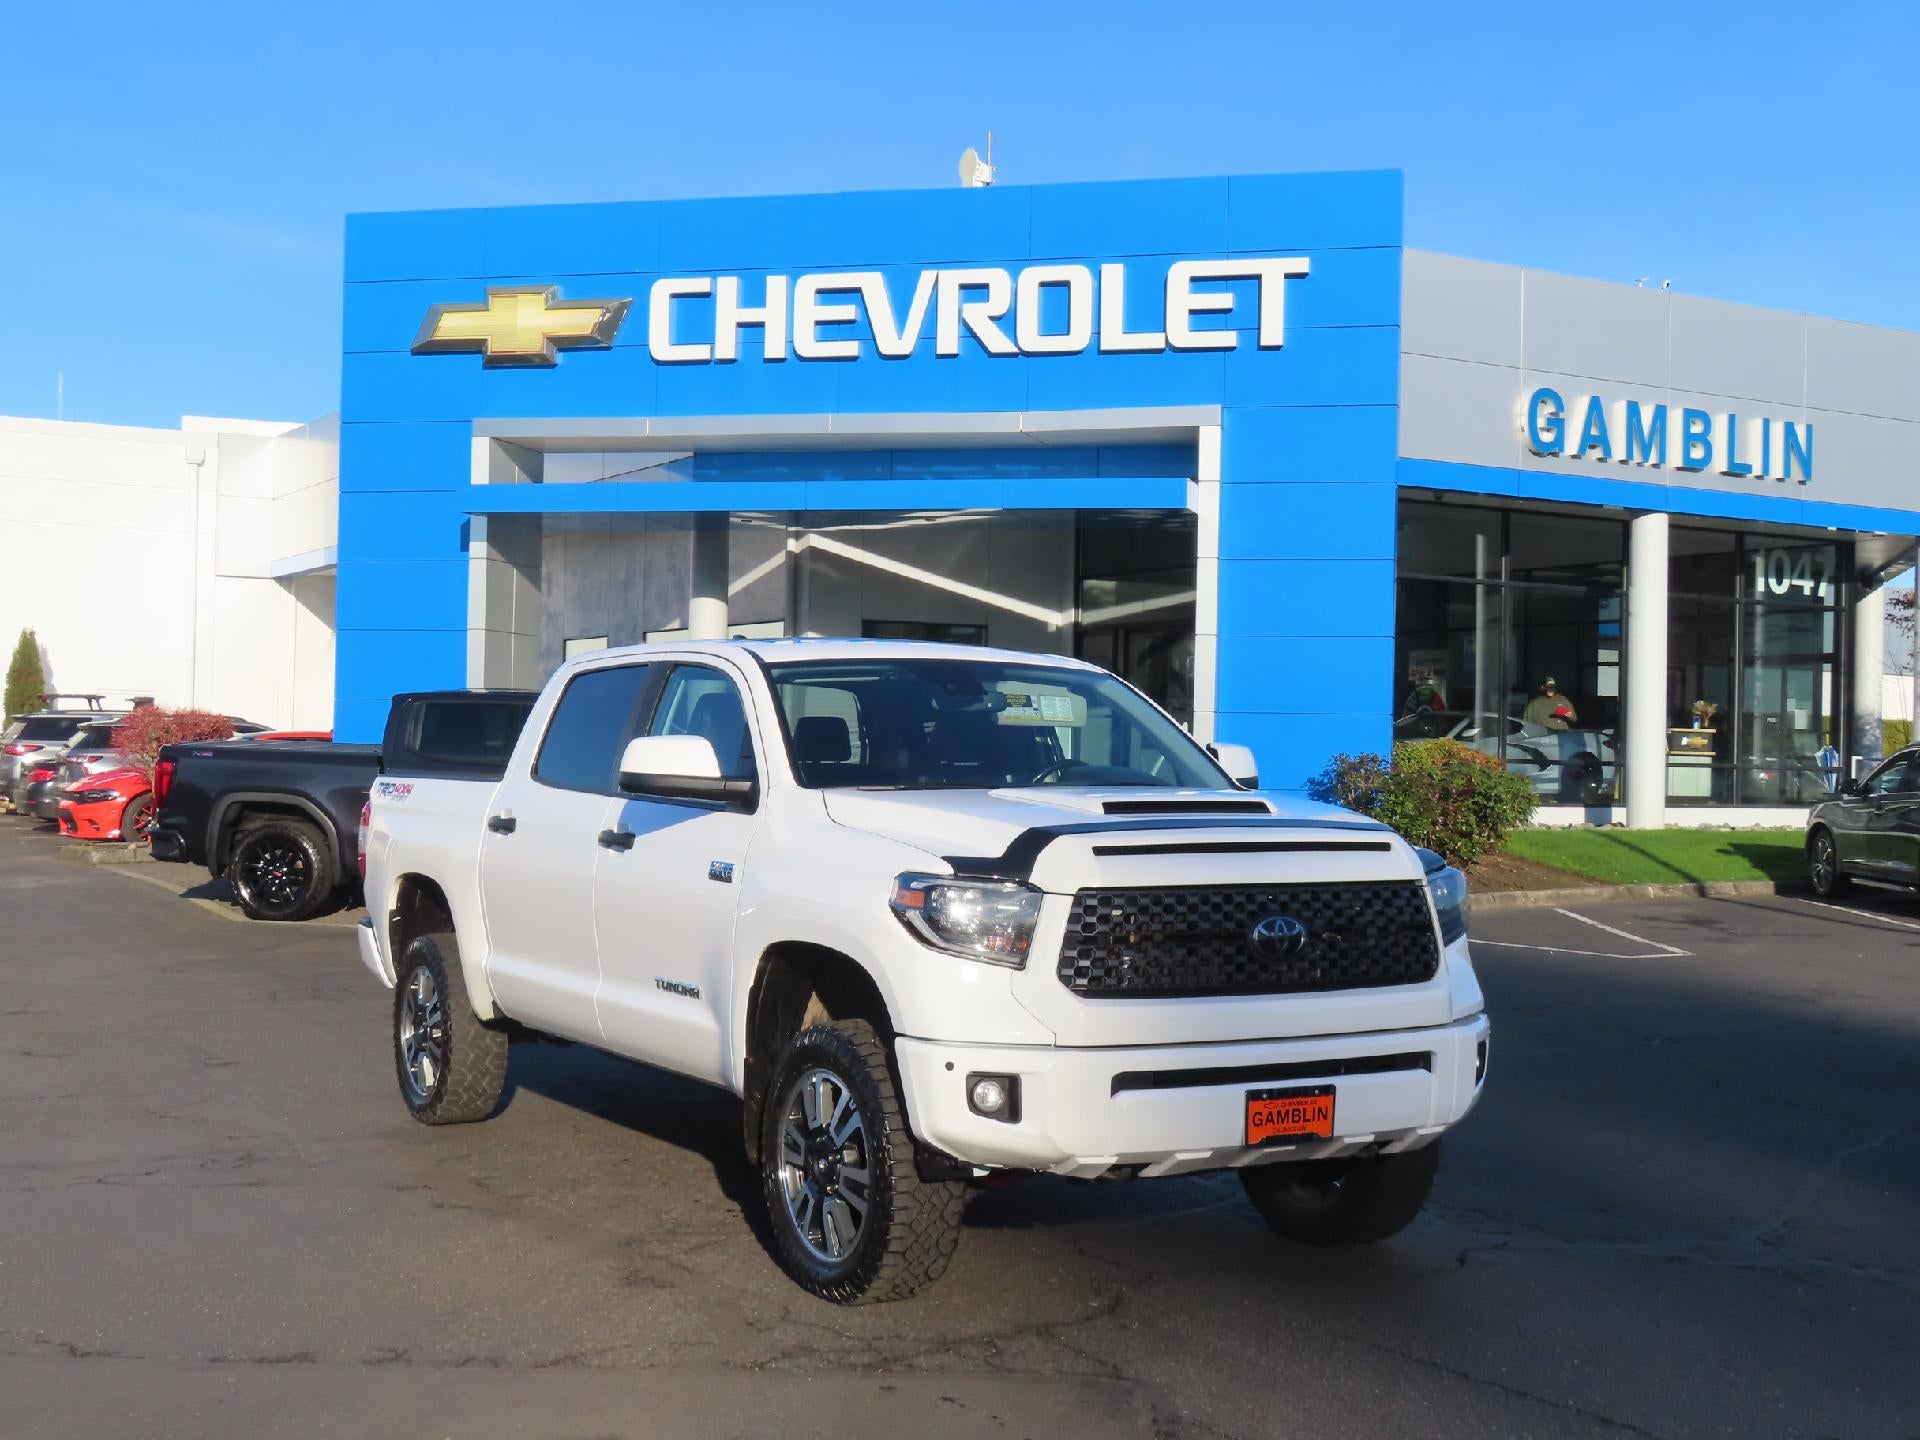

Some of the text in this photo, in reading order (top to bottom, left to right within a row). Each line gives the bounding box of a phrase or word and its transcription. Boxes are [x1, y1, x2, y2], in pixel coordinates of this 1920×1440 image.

[648, 256, 1310, 364] CHEVROLET
[1526, 387, 1813, 482] GAMBLIN
[1753, 549, 1835, 597] 1047
[654, 976, 701, 999] TUNDRA
[1252, 1106, 1328, 1127] GAMBLIN
